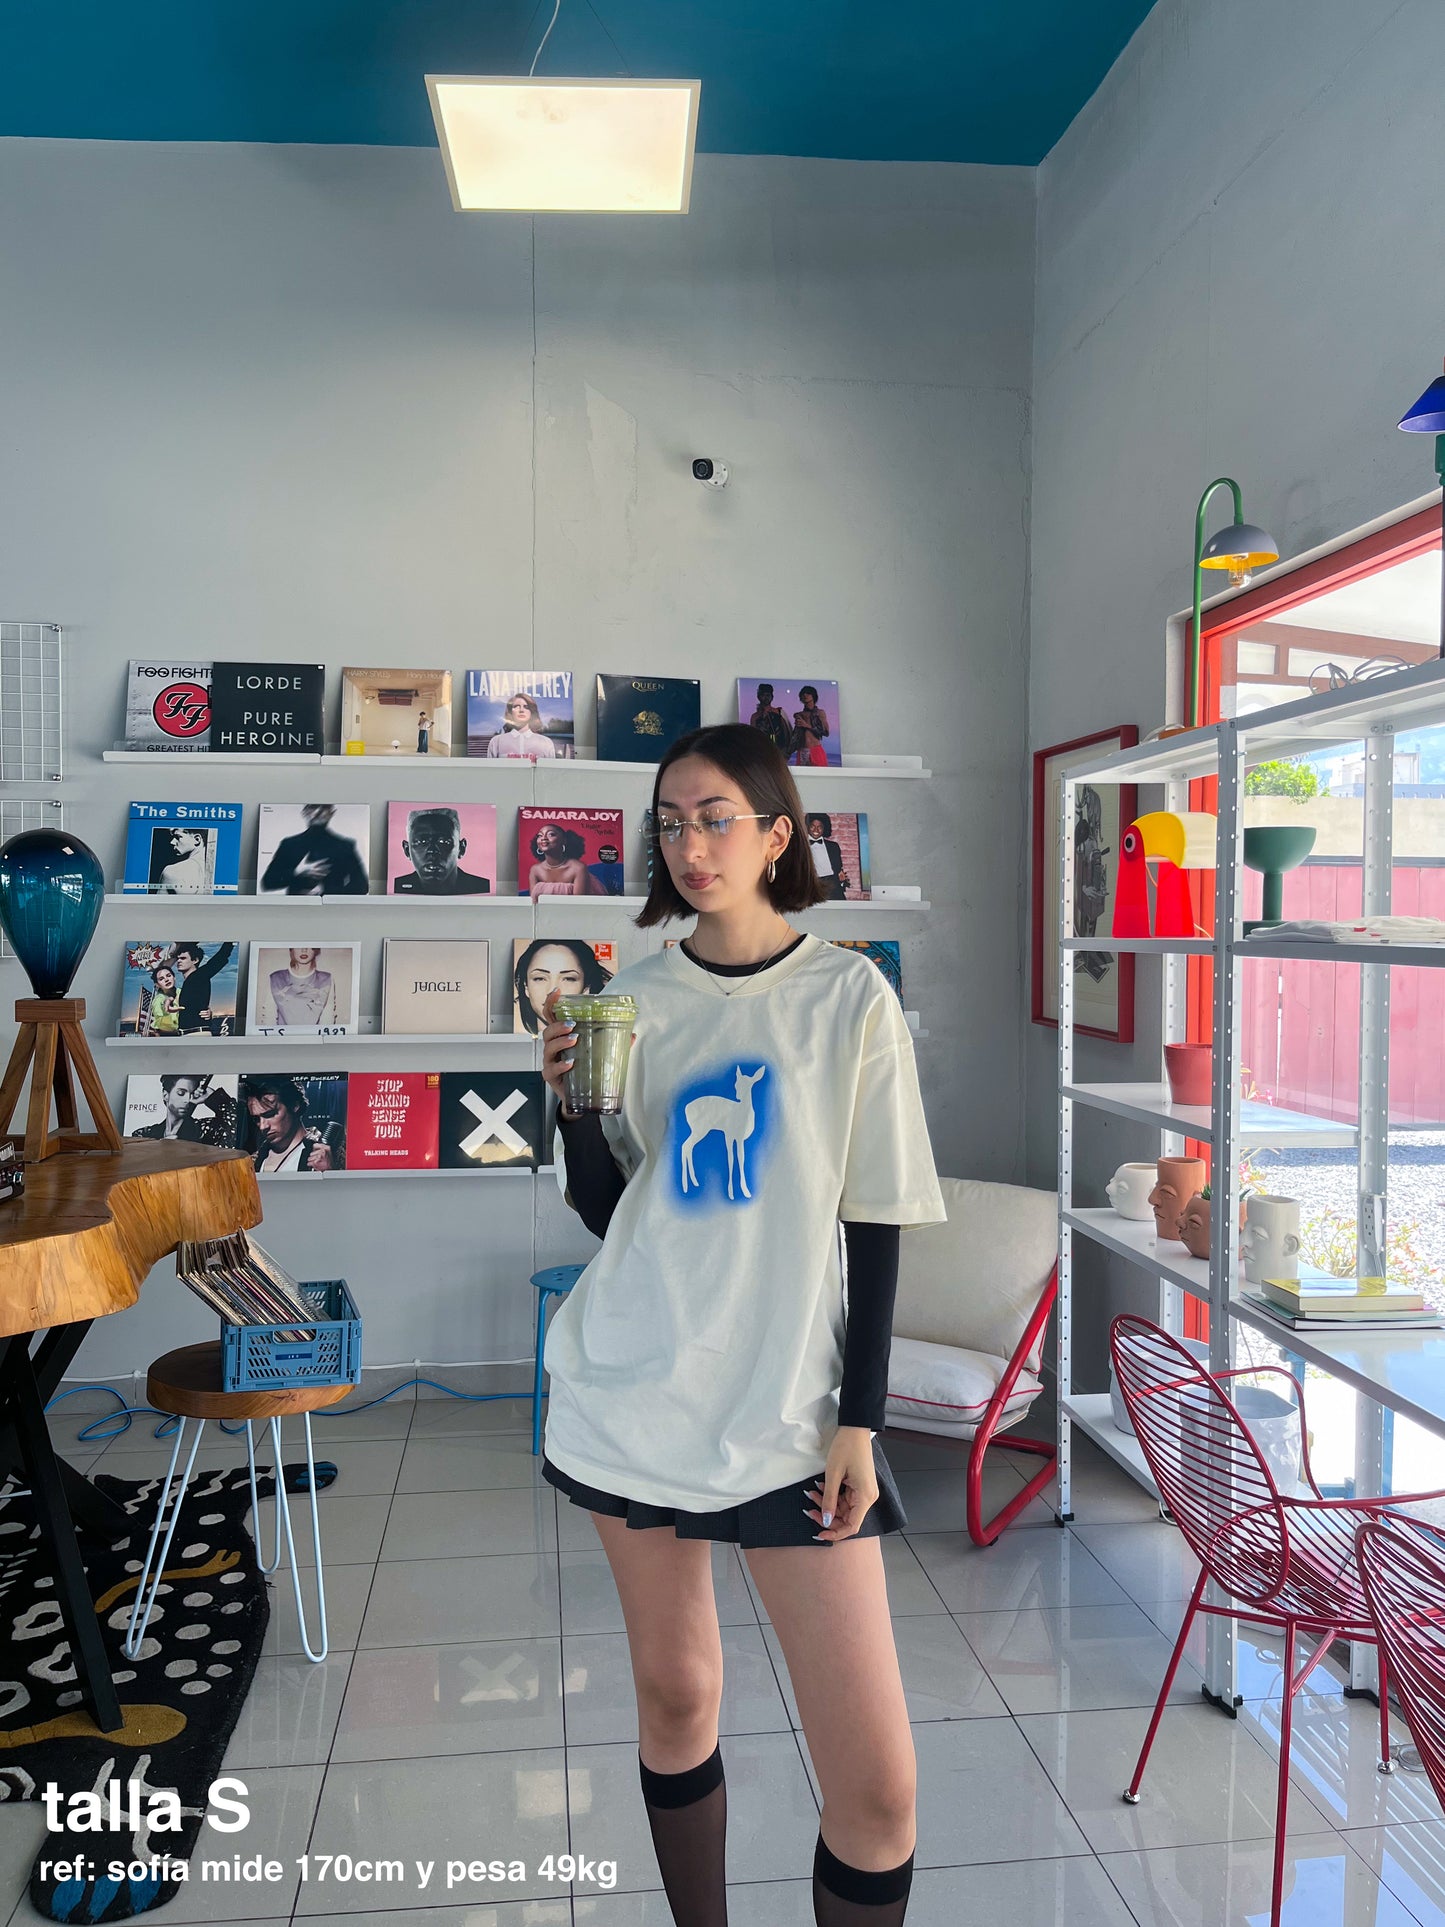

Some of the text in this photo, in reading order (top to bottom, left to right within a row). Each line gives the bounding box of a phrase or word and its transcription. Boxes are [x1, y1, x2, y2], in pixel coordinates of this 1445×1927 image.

[138, 667, 170, 678] FOO
[237, 676, 302, 690] LORDE
[470, 672, 571, 698] LANA DEL REY
[632, 682, 665, 692] QUEEN
[244, 712, 293, 725] PURE
[221, 732, 314, 746] HEROINE
[137, 806, 236, 818] The Smiths
[522, 810, 620, 822] SAMARA JOY
[412, 982, 462, 994] JUNGLE
[376, 1079, 404, 1092] STOP
[368, 1094, 410, 1108] MAKING
[372, 1110, 406, 1122] SENSE
[373, 1124, 402, 1138] TOUR
